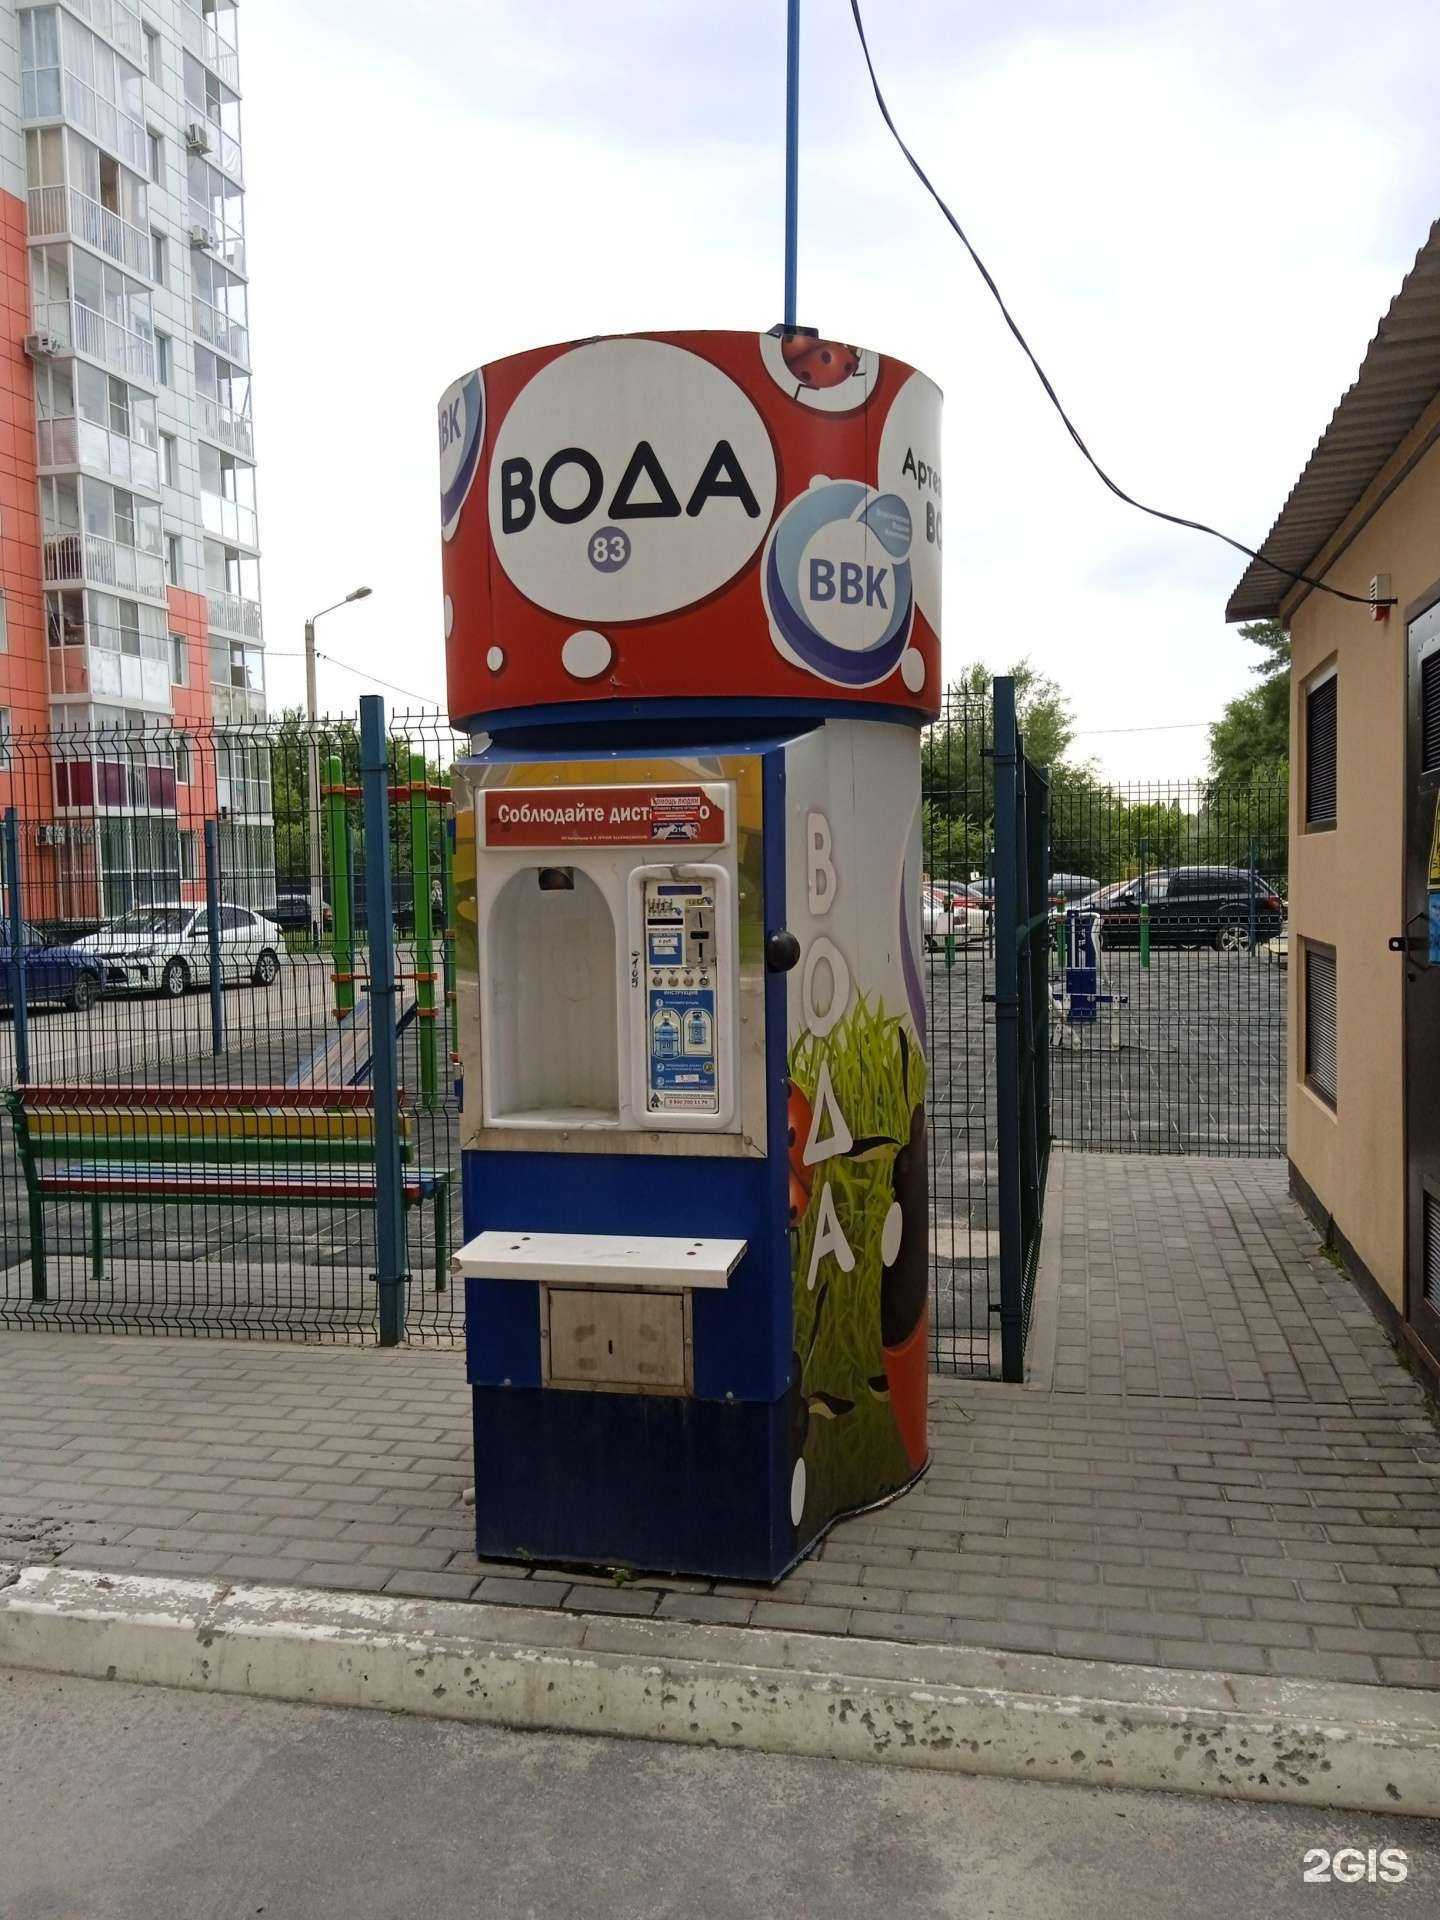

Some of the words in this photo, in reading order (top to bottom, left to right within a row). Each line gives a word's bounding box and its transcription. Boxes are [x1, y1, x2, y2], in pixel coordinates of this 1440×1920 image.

[439, 397, 462, 452] ВК
[501, 439, 762, 535] ВОДА
[592, 536, 626, 563] 83
[498, 802, 604, 824] Соблюдайте
[802, 811, 855, 1290] ВОДА
